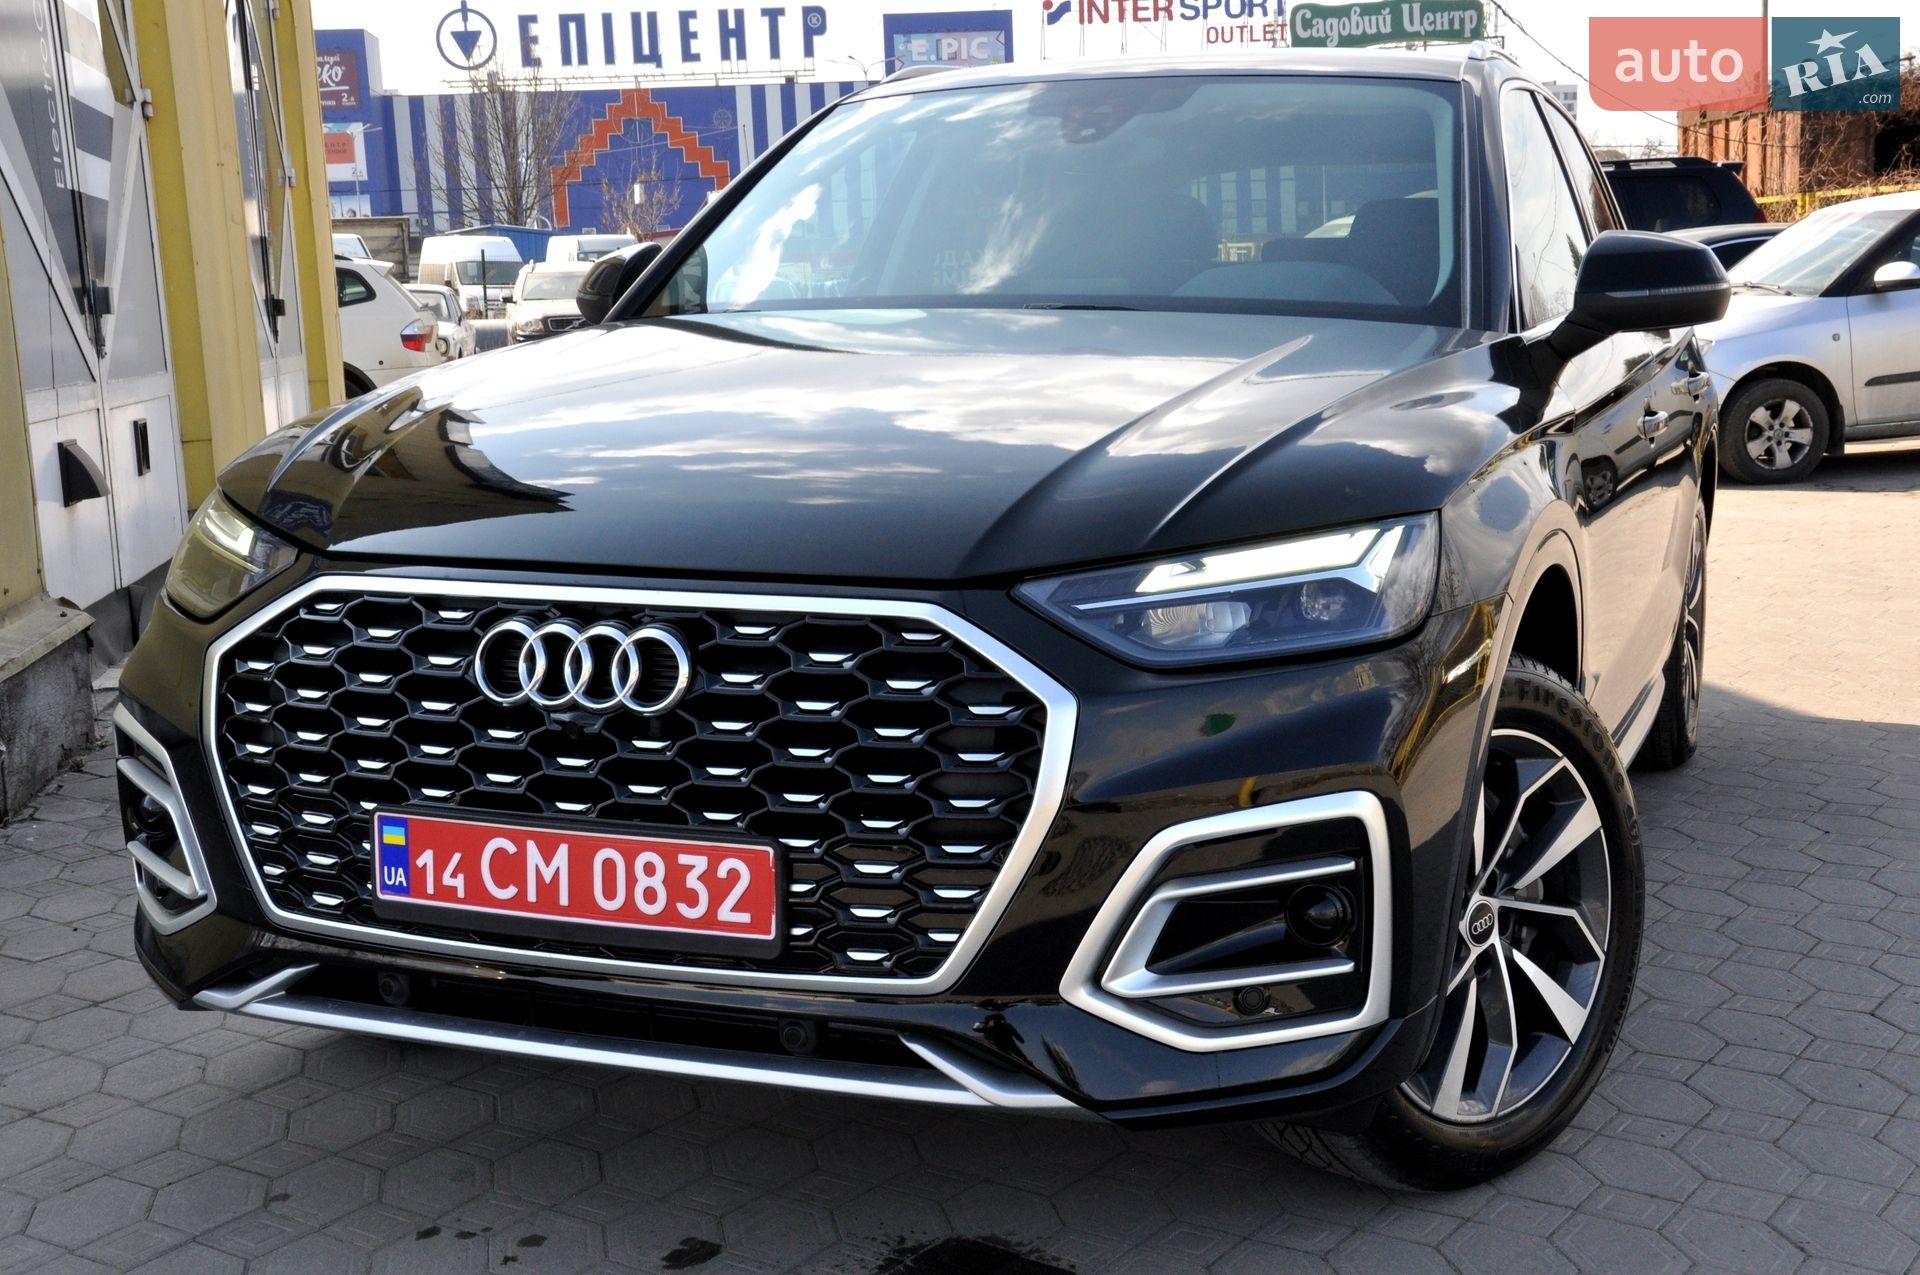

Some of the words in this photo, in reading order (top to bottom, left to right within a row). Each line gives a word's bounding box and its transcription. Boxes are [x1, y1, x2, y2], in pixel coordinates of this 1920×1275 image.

[518, 5, 827, 69] ЕПІЦЕНТР
[1206, 23, 1288, 44] OUTLET
[1295, 6, 1392, 47] Садовий
[1401, 2, 1478, 38] Центр
[384, 865, 407, 887] UA
[416, 849, 465, 899] 14
[480, 837, 569, 906] CM
[593, 848, 752, 924] 0832
